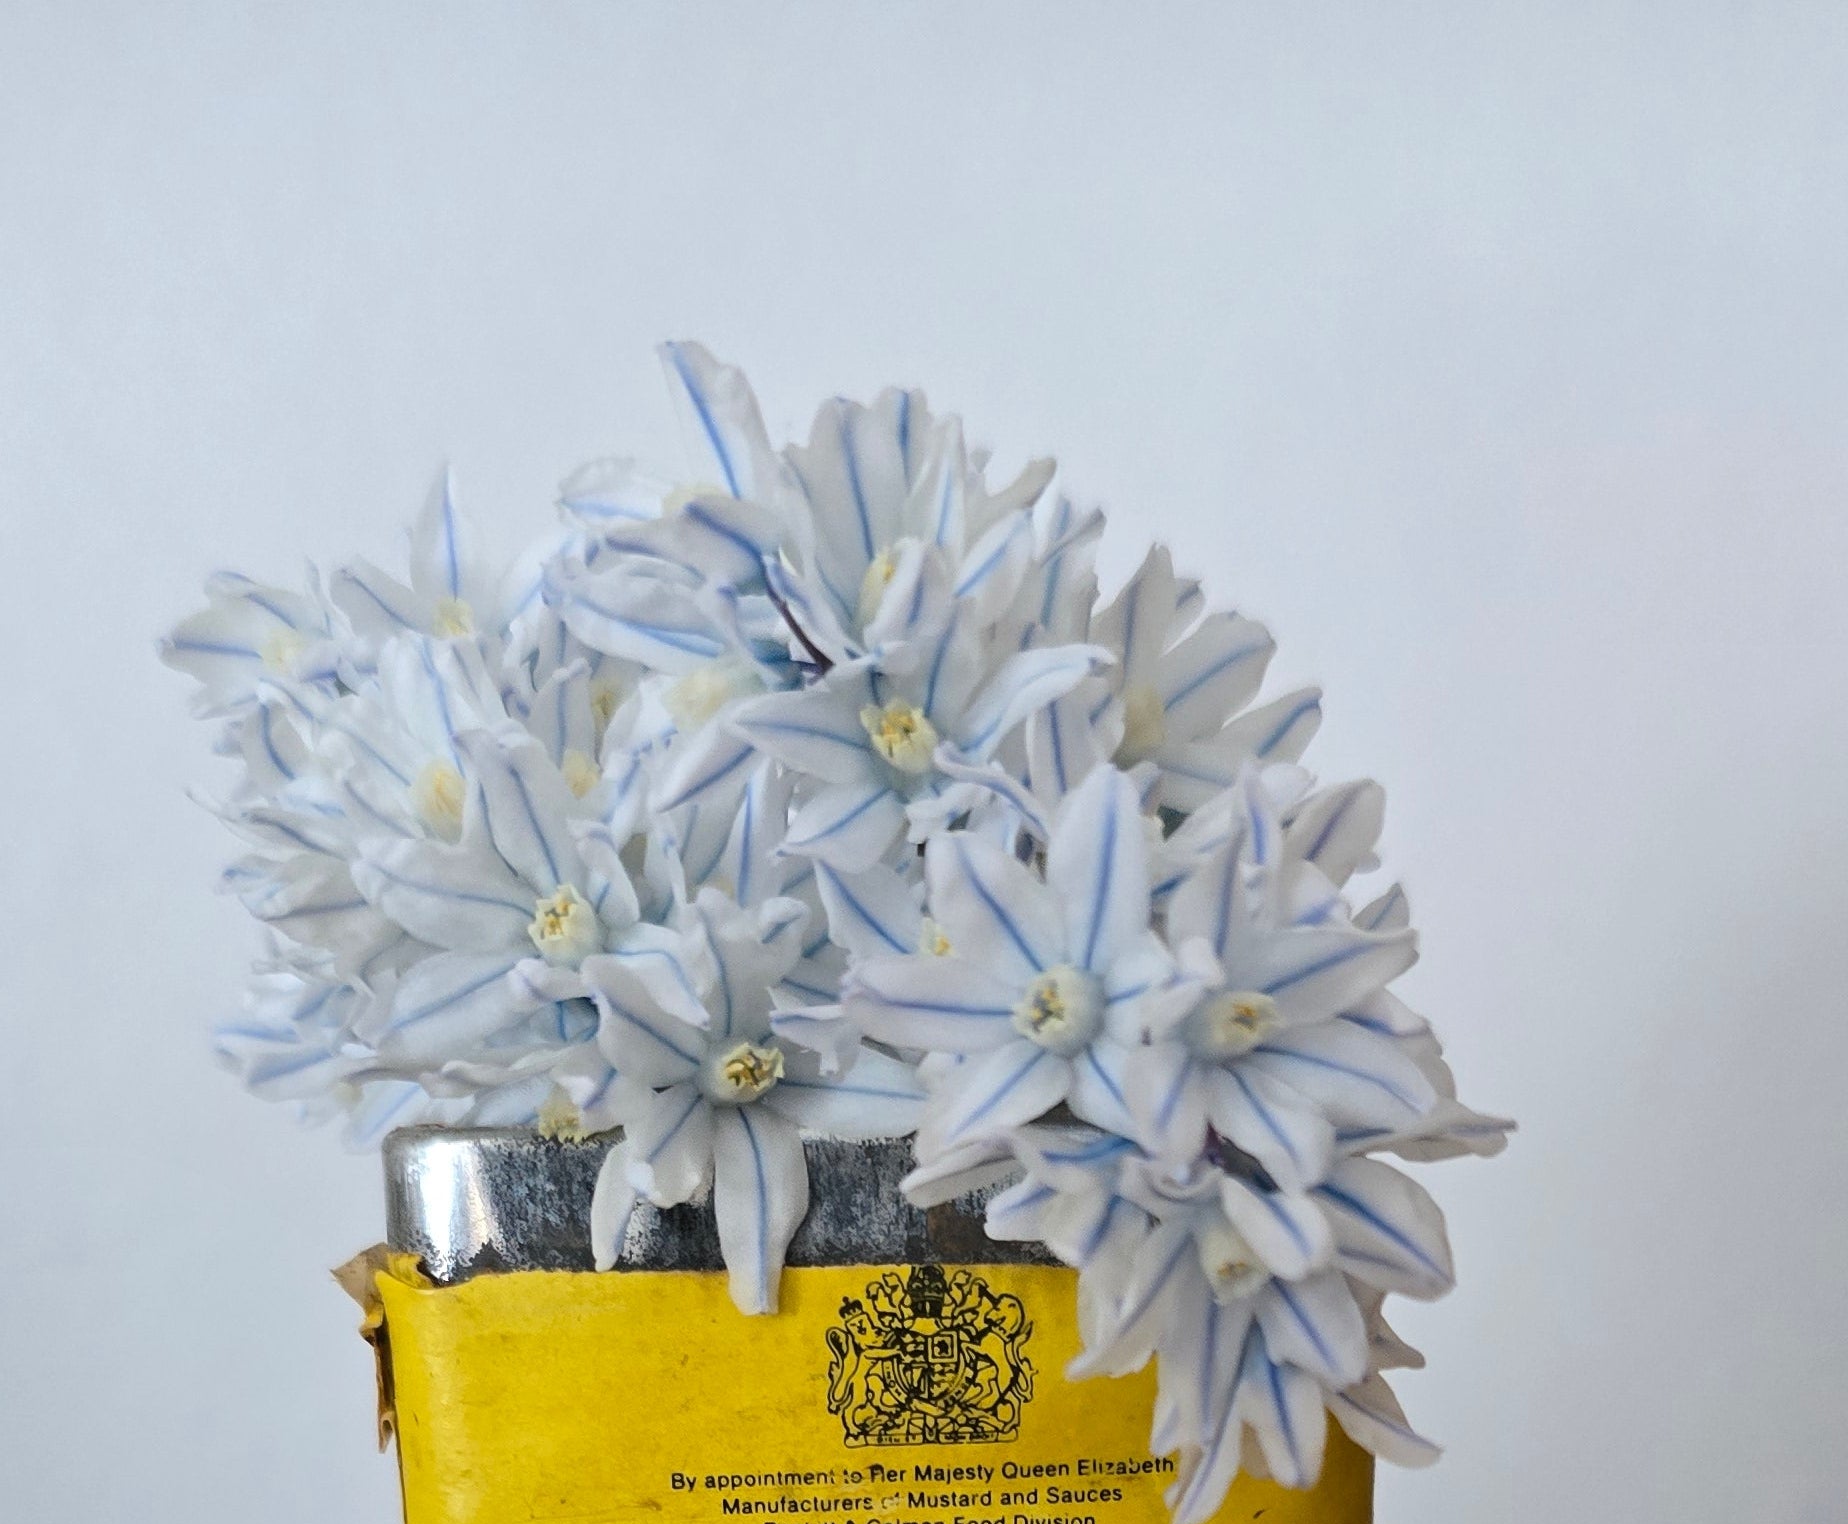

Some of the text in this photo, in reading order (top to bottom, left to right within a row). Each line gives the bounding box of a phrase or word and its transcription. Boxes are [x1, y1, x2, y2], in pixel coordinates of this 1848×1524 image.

[671, 1456, 1174, 1492] By appointment to Her Majesty Queen Elizabeth
[722, 1496, 873, 1515] Manufacturers
[908, 1490, 992, 1508] Mustard
[1000, 1488, 1038, 1506] and
[1046, 1485, 1123, 1504] Sauces
